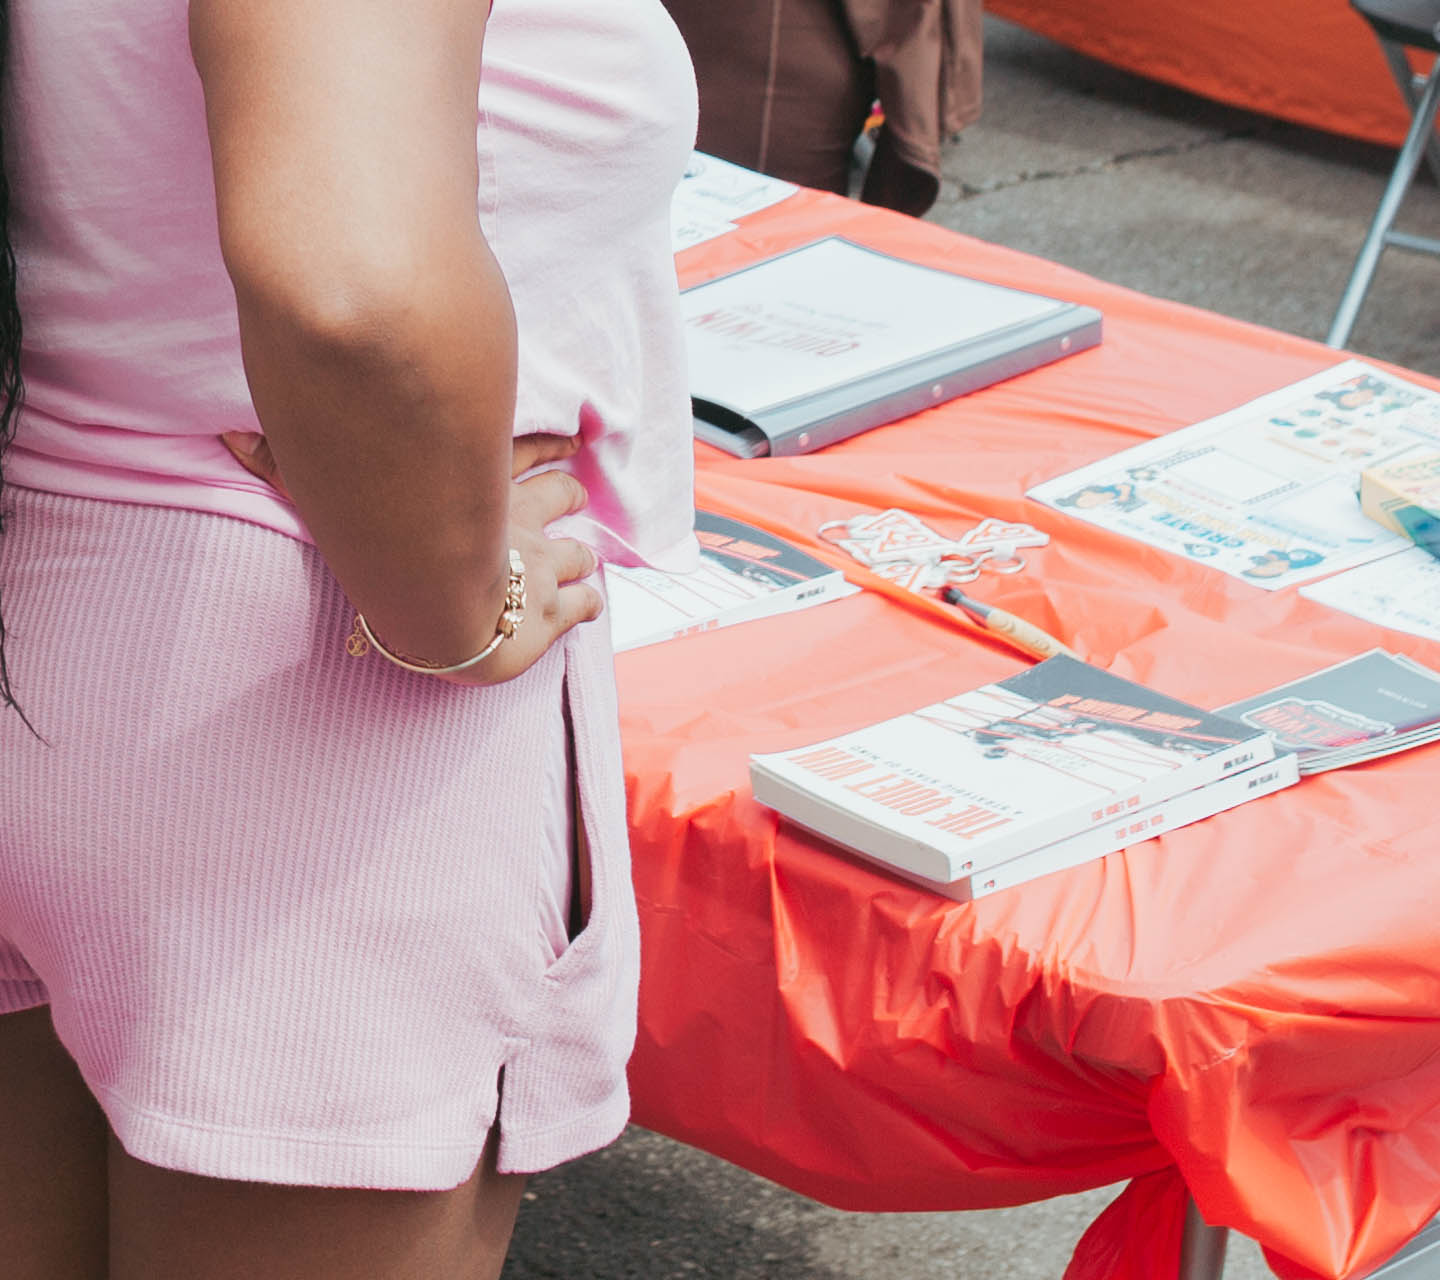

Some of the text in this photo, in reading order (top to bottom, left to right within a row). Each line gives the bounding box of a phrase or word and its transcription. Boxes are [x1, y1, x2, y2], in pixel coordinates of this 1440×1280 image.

[786, 745, 1015, 840] THE QUIET WIN
